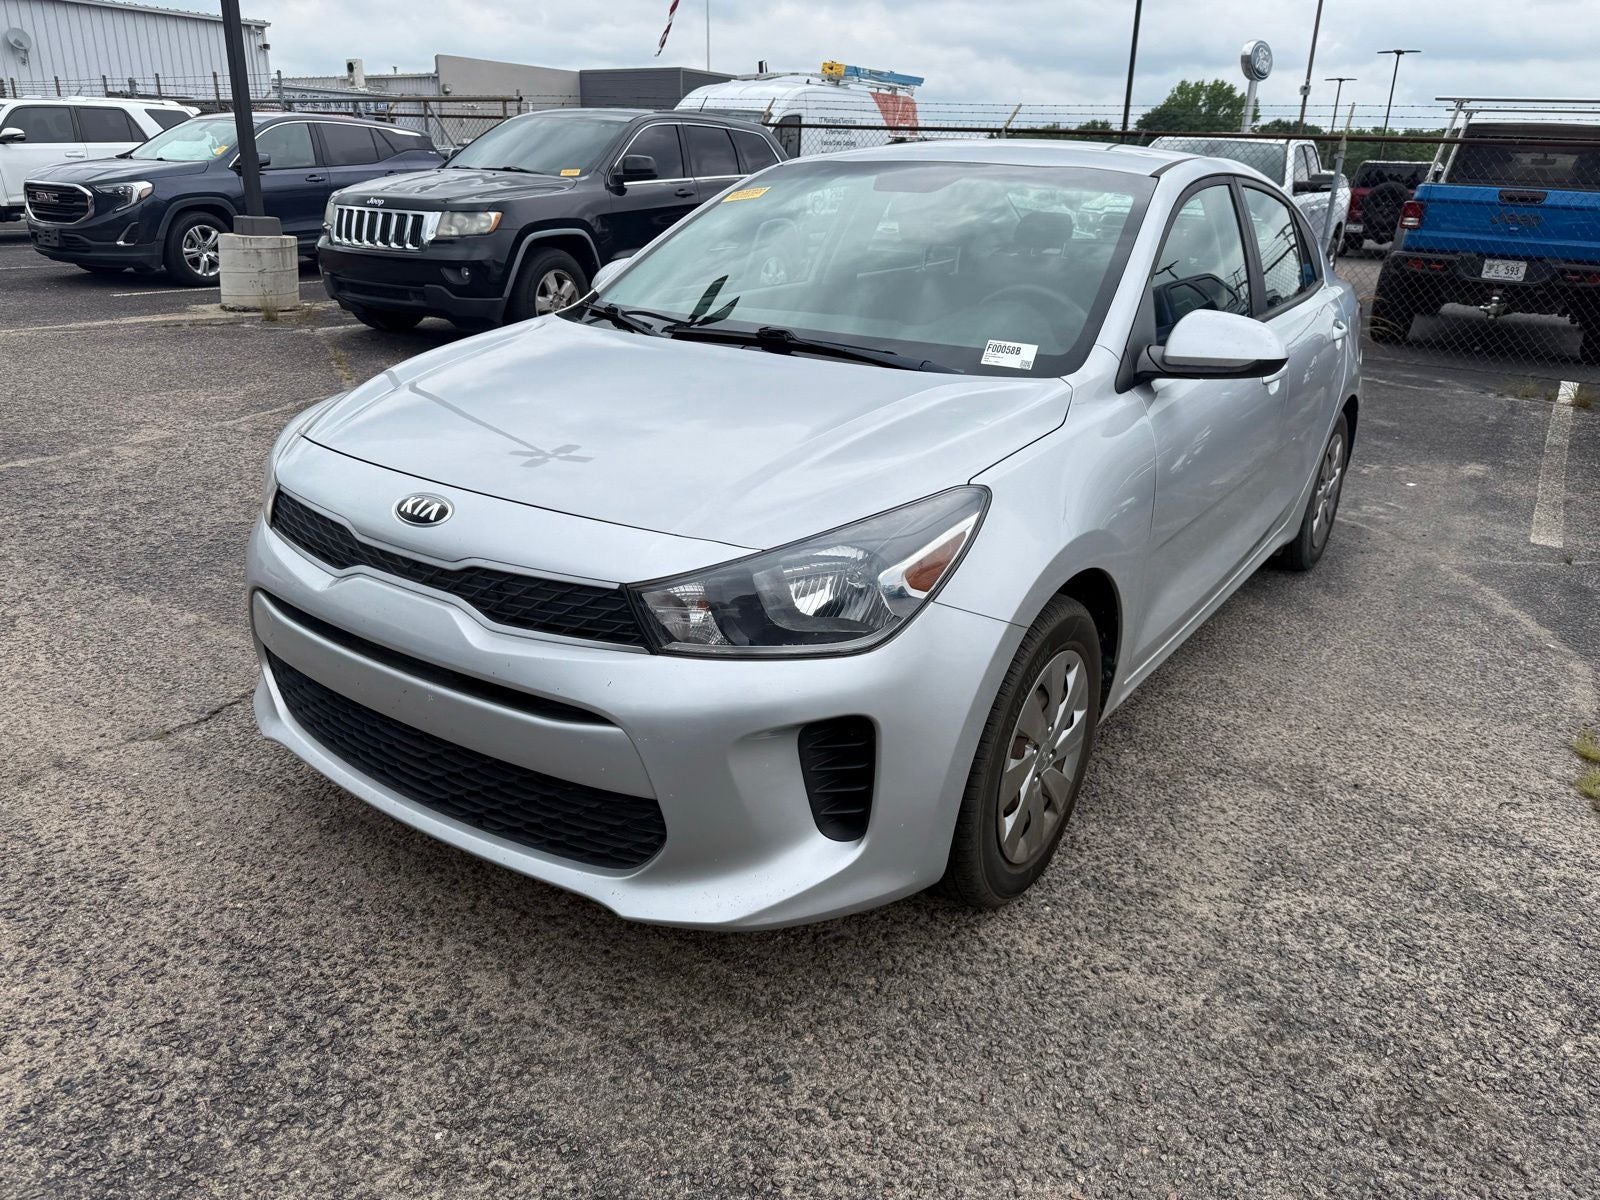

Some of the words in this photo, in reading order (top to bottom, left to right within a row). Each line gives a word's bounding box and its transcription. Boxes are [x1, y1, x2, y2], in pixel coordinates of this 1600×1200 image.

[1255, 47, 1270, 74] Ford
[36, 191, 59, 203] GMC
[367, 196, 385, 207] Jeep
[1490, 209, 1542, 229] Jeep
[1504, 265, 1520, 276] 593
[986, 343, 1022, 356] F00058B
[400, 496, 441, 521] KIA
